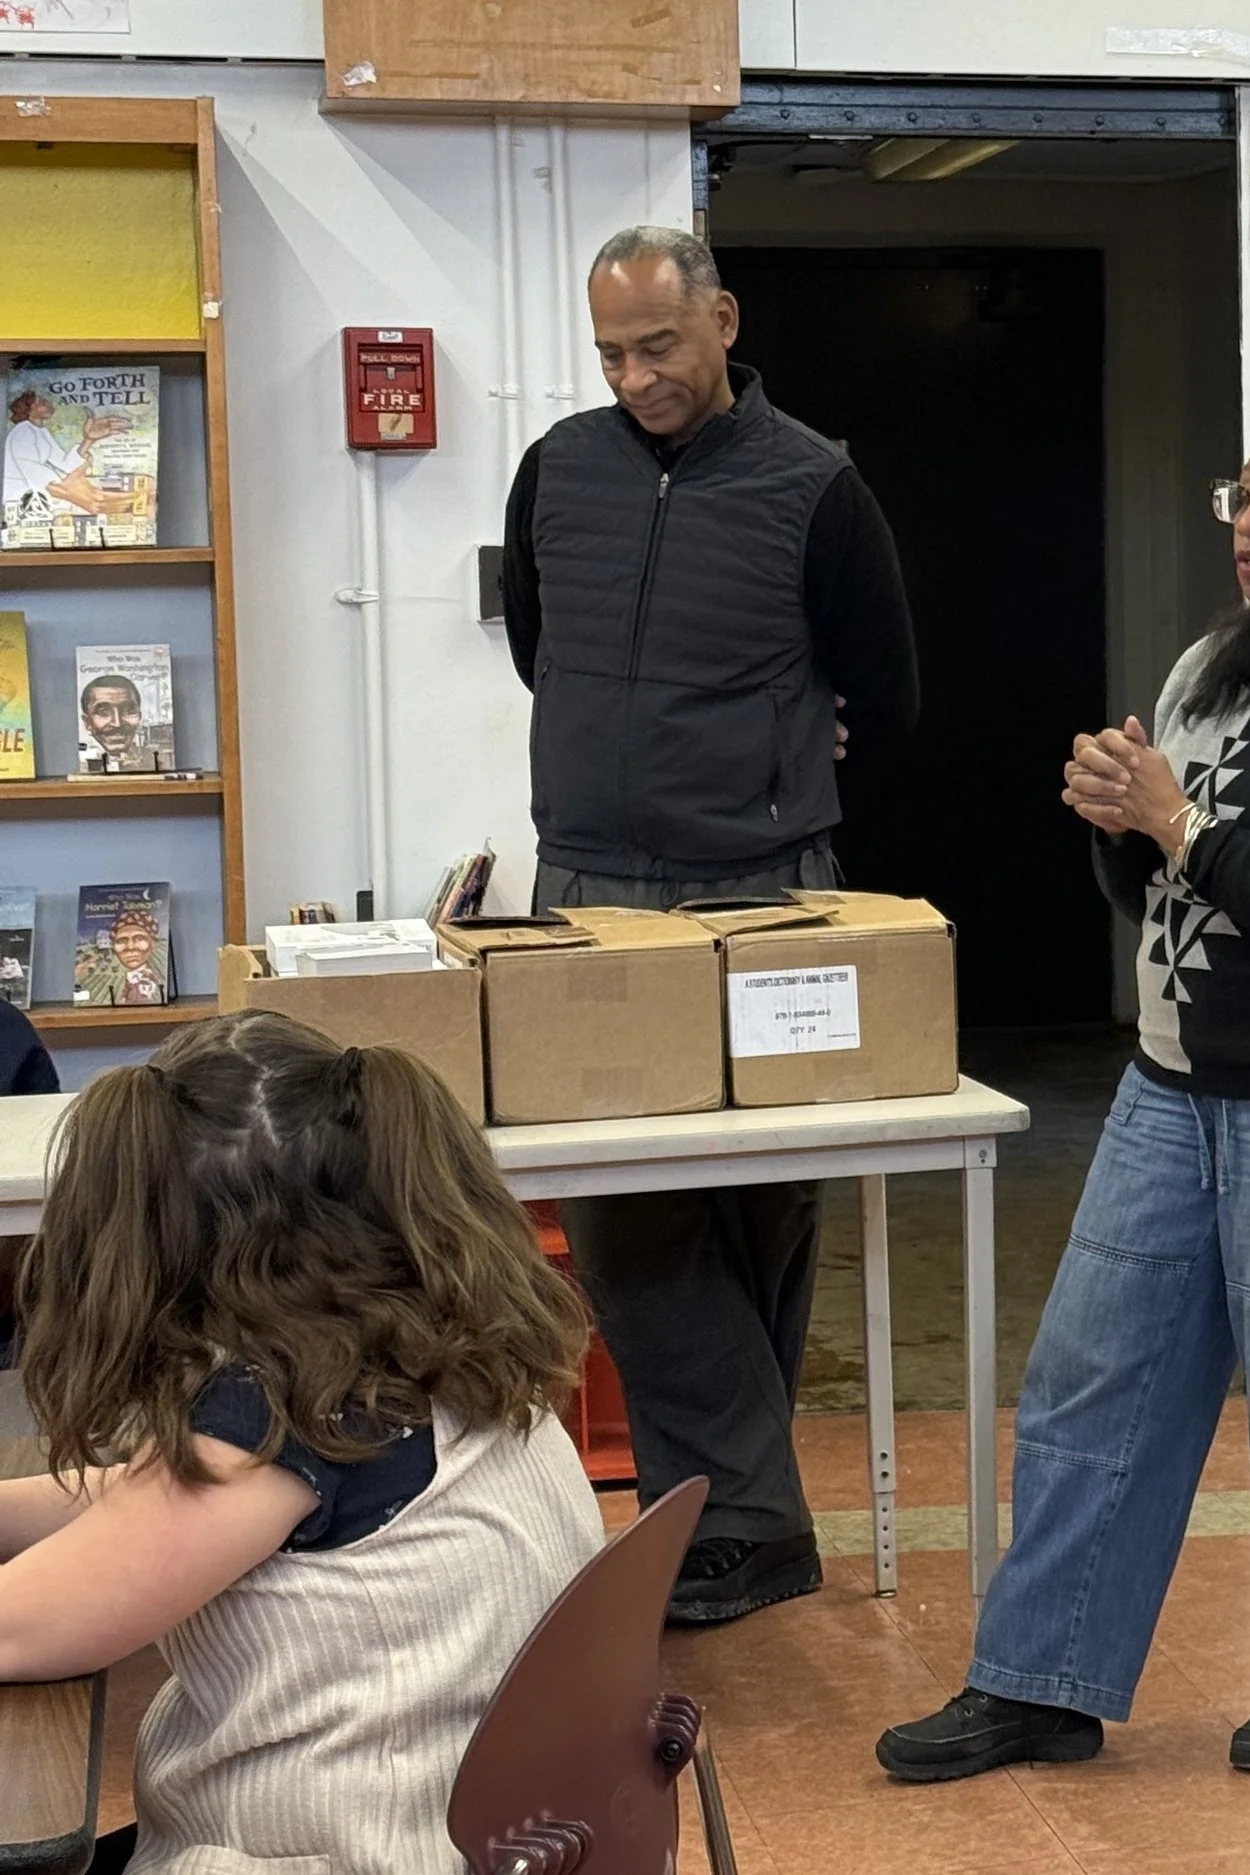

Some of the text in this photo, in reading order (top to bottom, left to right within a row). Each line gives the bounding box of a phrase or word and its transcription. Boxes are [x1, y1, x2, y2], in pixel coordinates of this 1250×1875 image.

[361, 353, 420, 362] PULL DOWN
[50, 374, 145, 394] GO FORTH
[58, 391, 150, 406] AND TELL
[363, 394, 421, 405] FIRE
[80, 664, 115, 674] George
[0, 728, 25, 752] LE
[84, 902, 119, 911] Harriet
[790, 1026, 804, 1034] QTY
